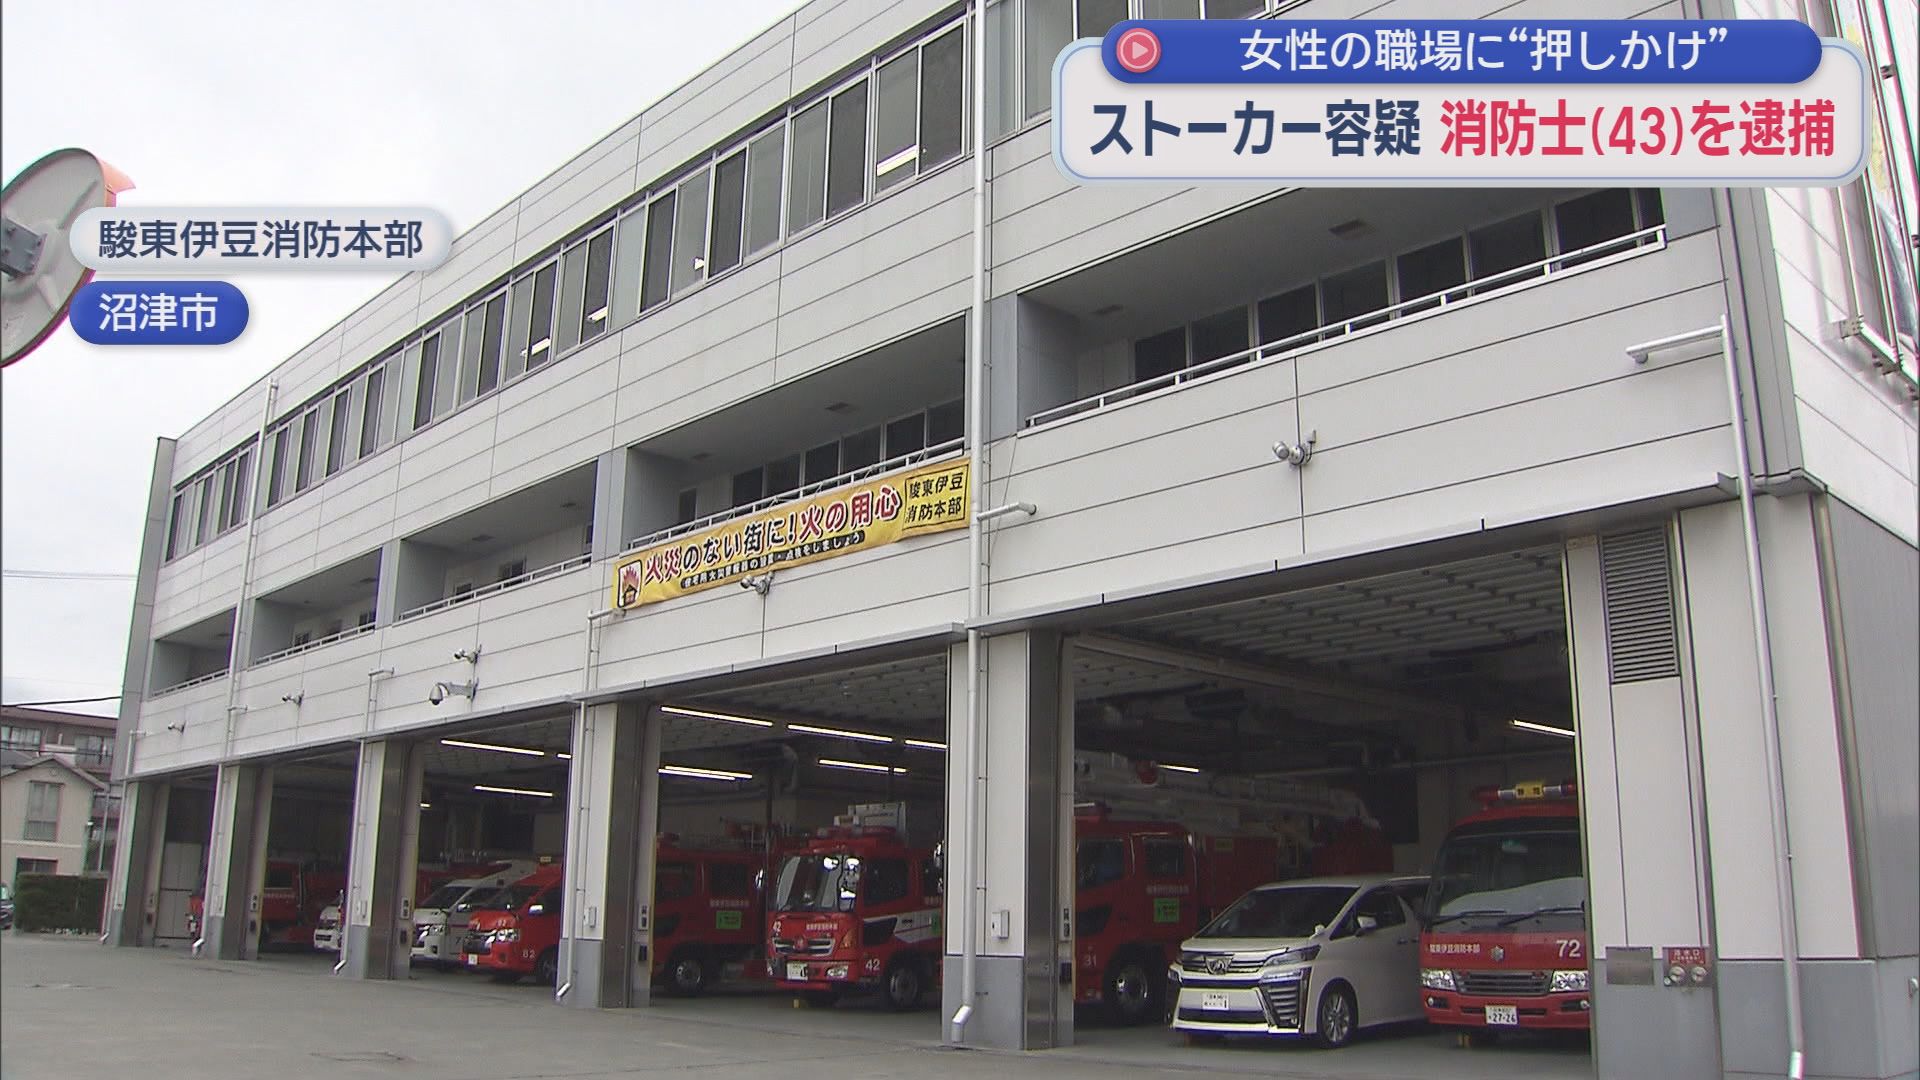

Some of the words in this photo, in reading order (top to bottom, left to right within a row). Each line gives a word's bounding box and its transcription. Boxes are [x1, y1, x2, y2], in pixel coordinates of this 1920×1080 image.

[909, 472, 964, 498] 駿東伊豆
[905, 496, 962, 523] 消防本部
[1556, 939, 1581, 958] 72
[865, 958, 880, 972] 42
